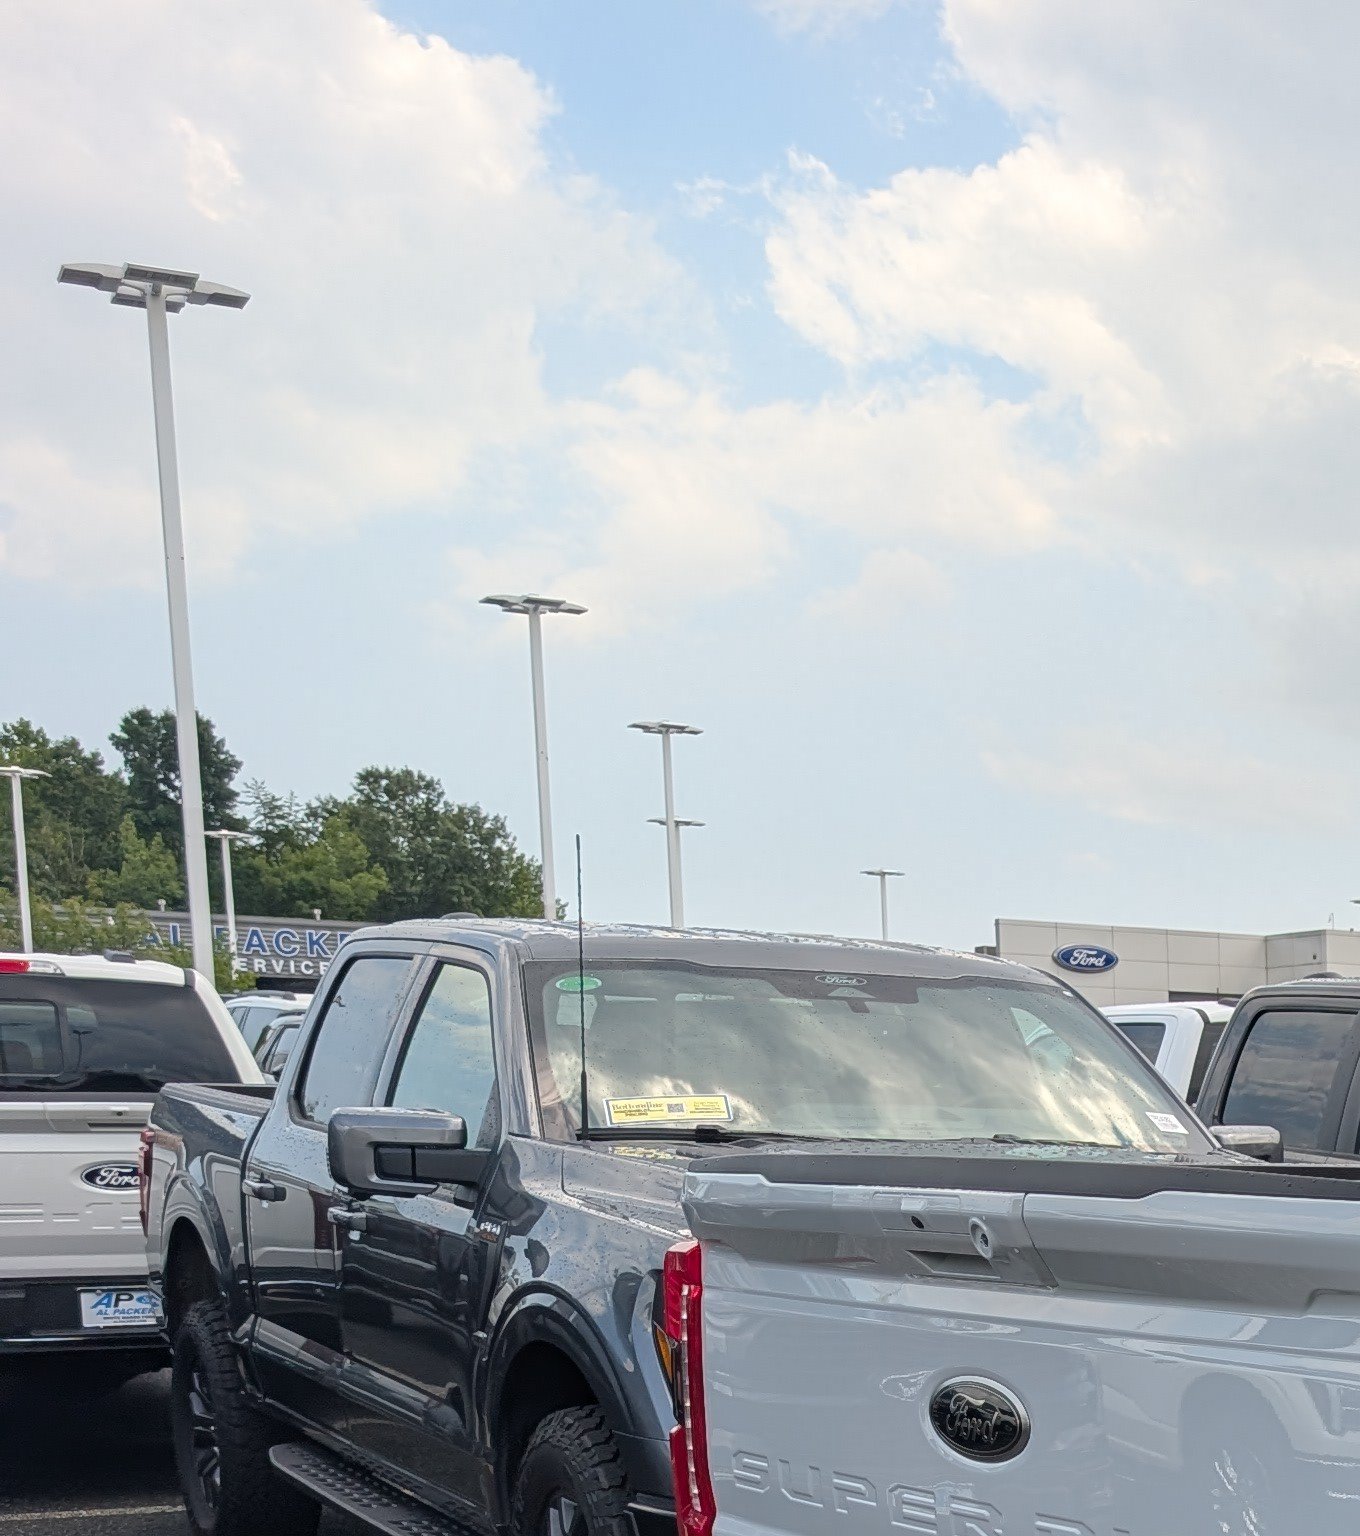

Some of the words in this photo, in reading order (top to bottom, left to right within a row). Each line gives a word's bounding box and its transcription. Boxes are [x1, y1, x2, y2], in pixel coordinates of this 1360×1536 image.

[231, 957, 331, 976] ERVICE
[1070, 949, 1107, 967] Ford
[946, 1392, 998, 1445] Ford
